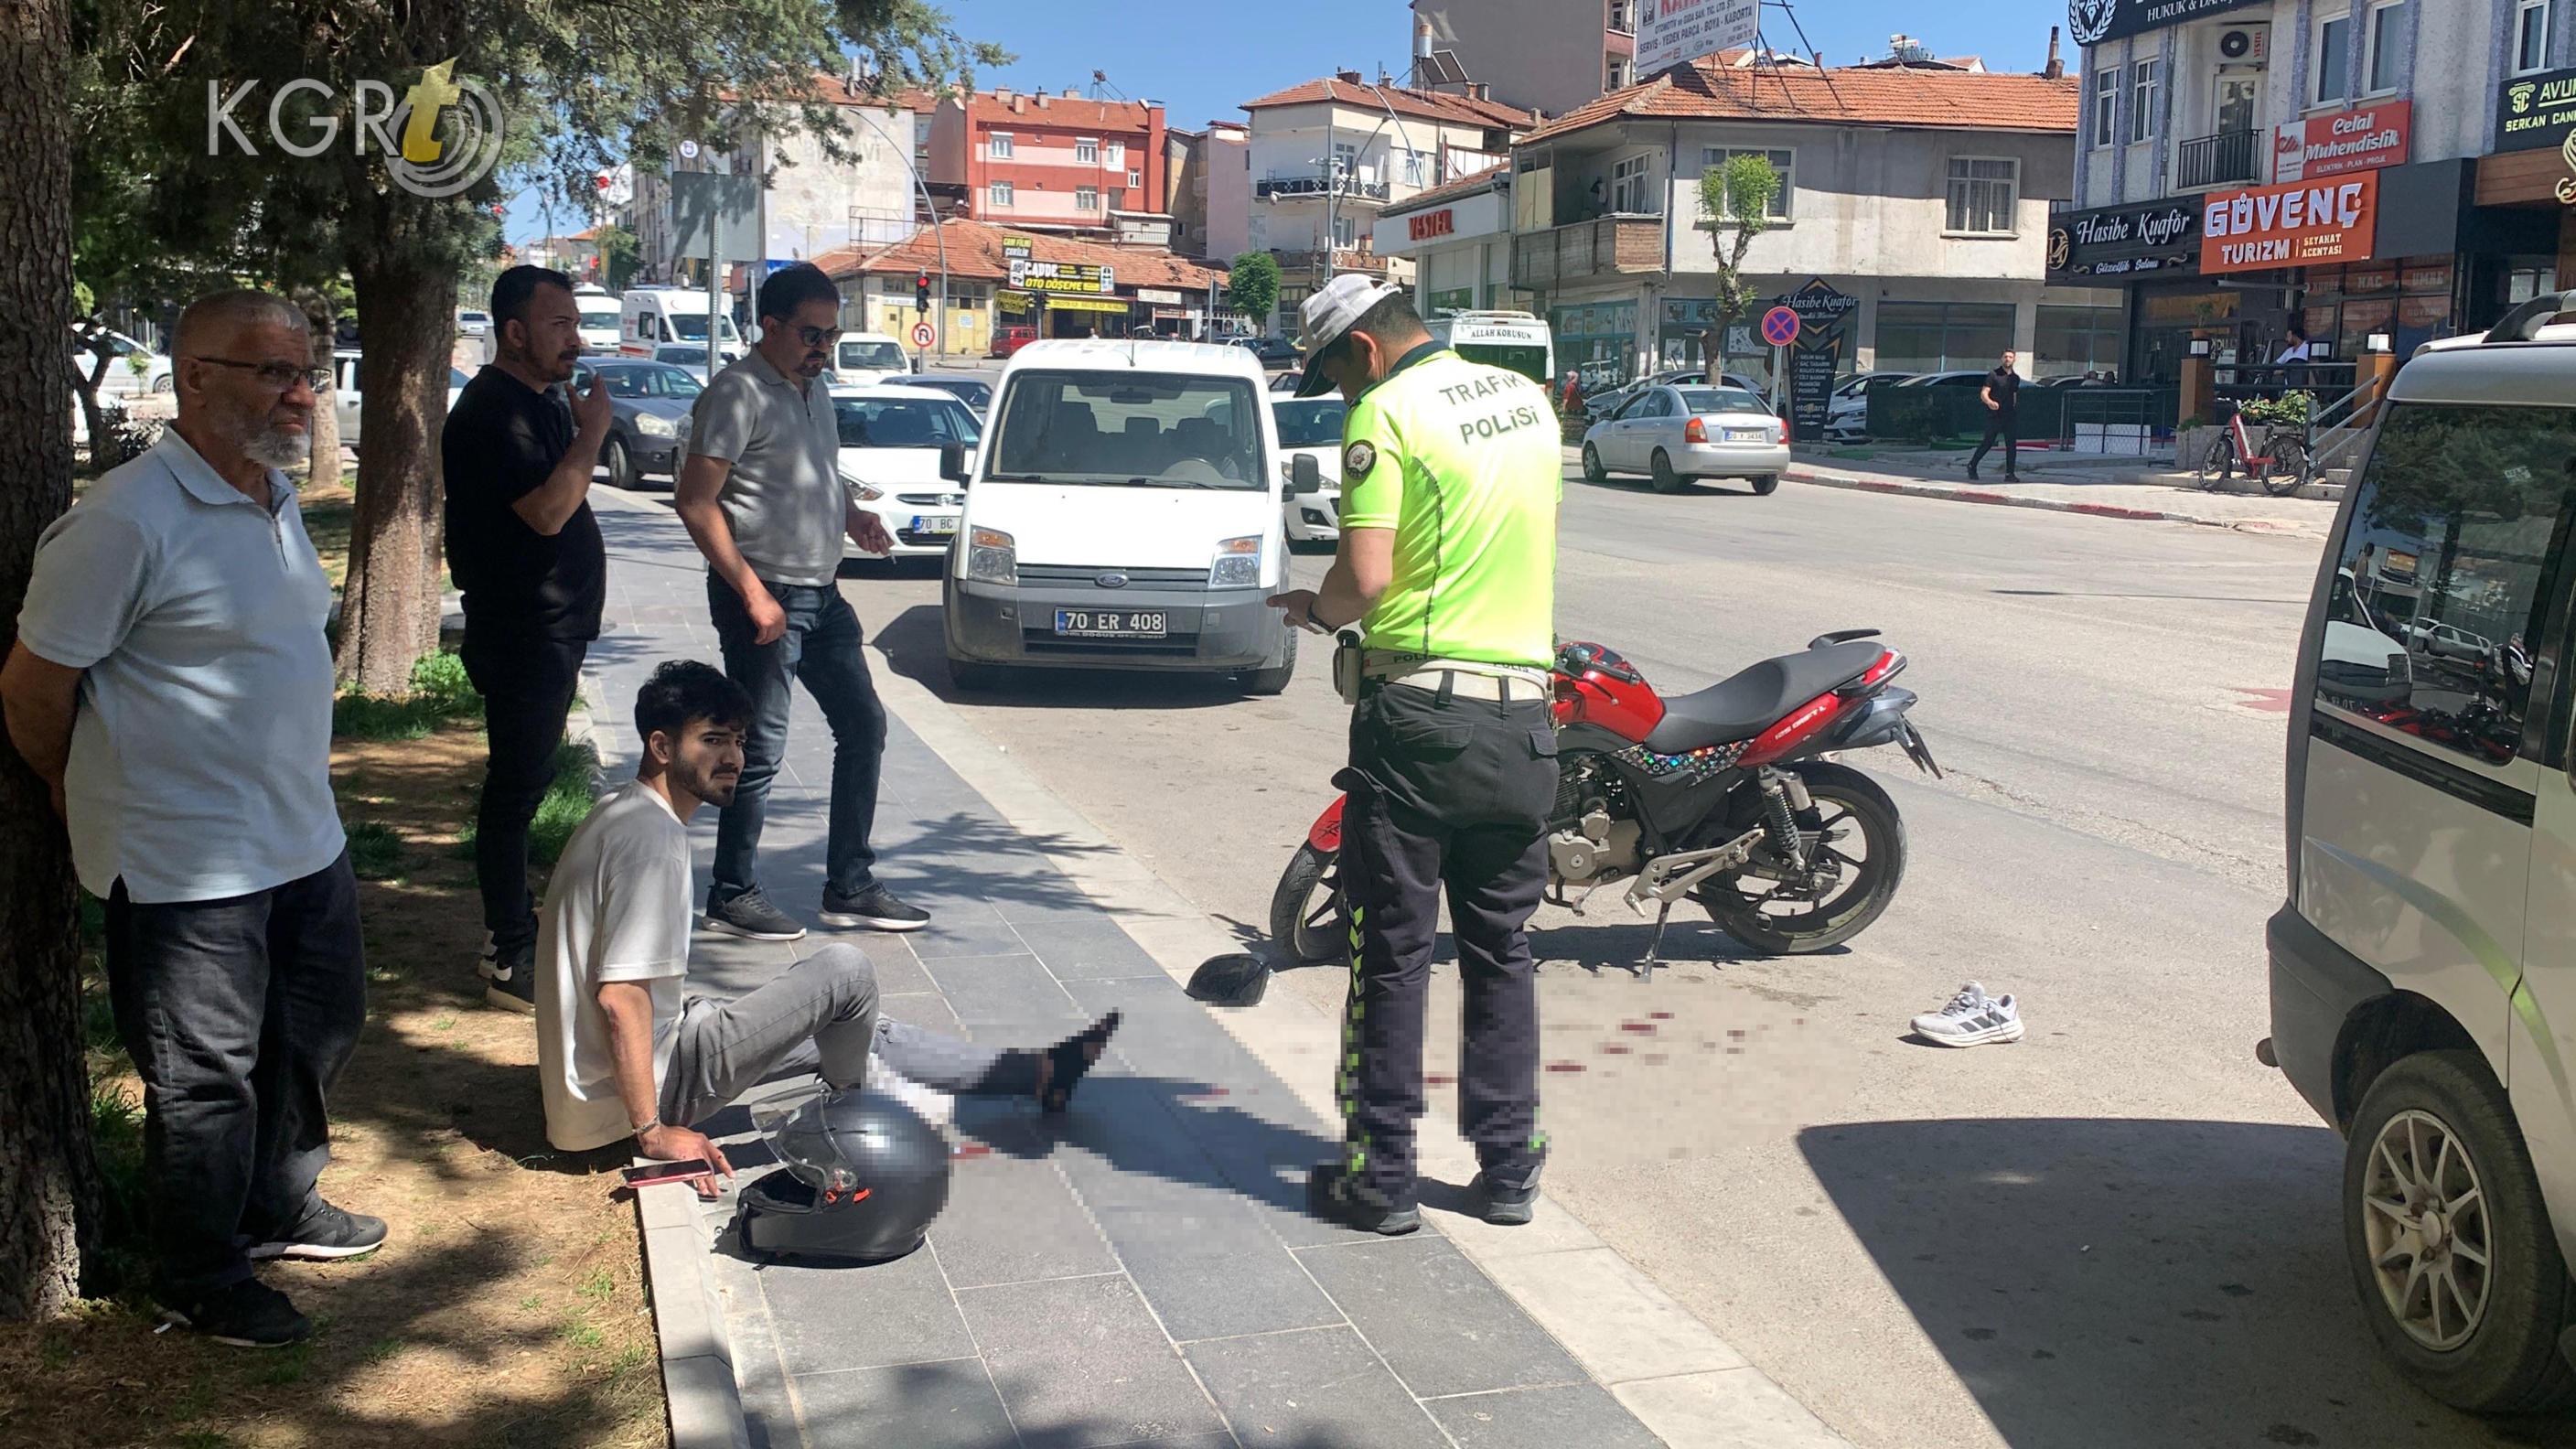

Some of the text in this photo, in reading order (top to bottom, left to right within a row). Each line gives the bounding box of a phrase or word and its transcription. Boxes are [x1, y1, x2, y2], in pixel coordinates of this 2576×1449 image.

[2147, 3, 2186, 22] HUKUK
[1662, 32, 1680, 46] YEDEK
[1704, 19, 1720, 34] BOYA
[2333, 112, 2377, 135] Celal
[2505, 115, 2547, 133] SERKAN
[2303, 128, 2399, 164] Muhendislik
[2347, 158, 2364, 169] PLAN
[2367, 155, 2387, 165] PROJE
[2205, 182, 2364, 238] GÜVENÇ
[1409, 209, 1453, 241] VESTEL
[2077, 209, 2190, 245] Hasibe Kuaför
[2303, 233, 2342, 247] SEYAHAT
[2302, 244, 2342, 258] ACENTASI
[1025, 262, 1058, 277] CADDE
[2412, 271, 2444, 285] UMRE
[1025, 277, 1044, 288] OTO
[1046, 278, 1082, 291] DÖŞEME
[1784, 293, 1858, 312] Hasibe Kuaför
[1471, 328, 1495, 338] ALLAH
[920, 518, 953, 530] 70 BC
[1066, 612, 1163, 630] 70 ER 408
